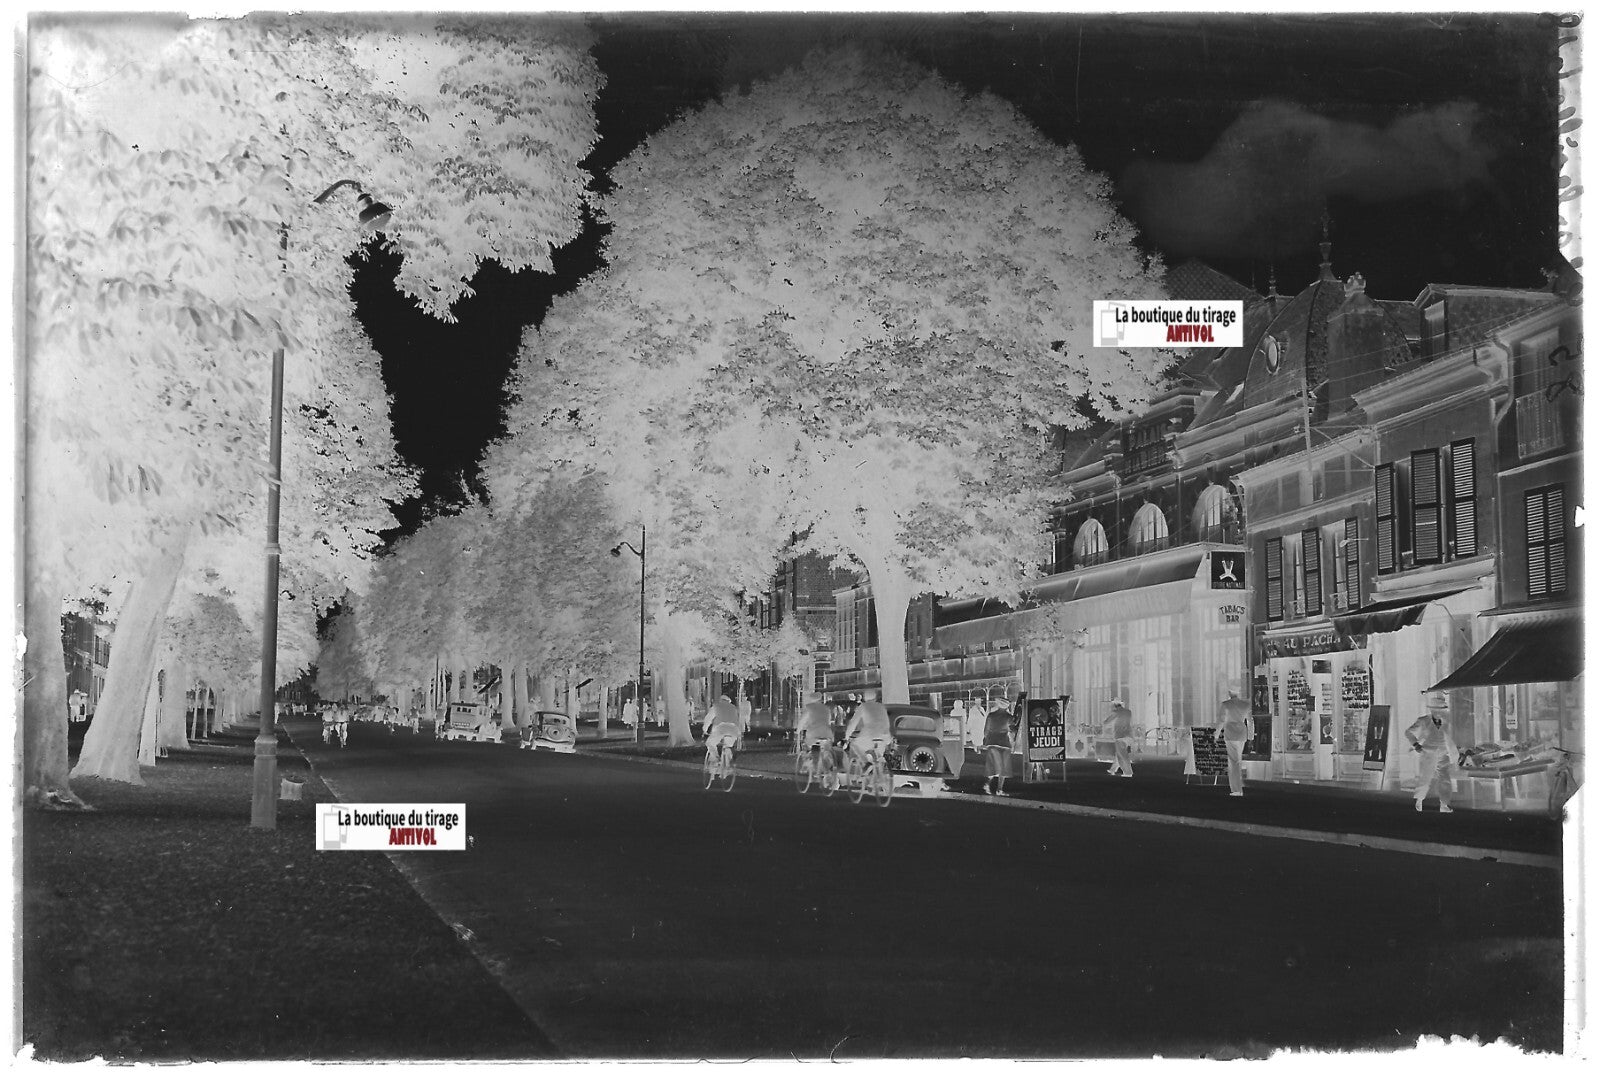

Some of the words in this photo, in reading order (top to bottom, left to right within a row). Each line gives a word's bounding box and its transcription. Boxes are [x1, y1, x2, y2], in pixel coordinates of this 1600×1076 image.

[1219, 604, 1246, 615] TABACS
[1226, 614, 1240, 623] BAR
[1030, 726, 1063, 737] TIRAGE
[1034, 737, 1060, 747] JEUDI
